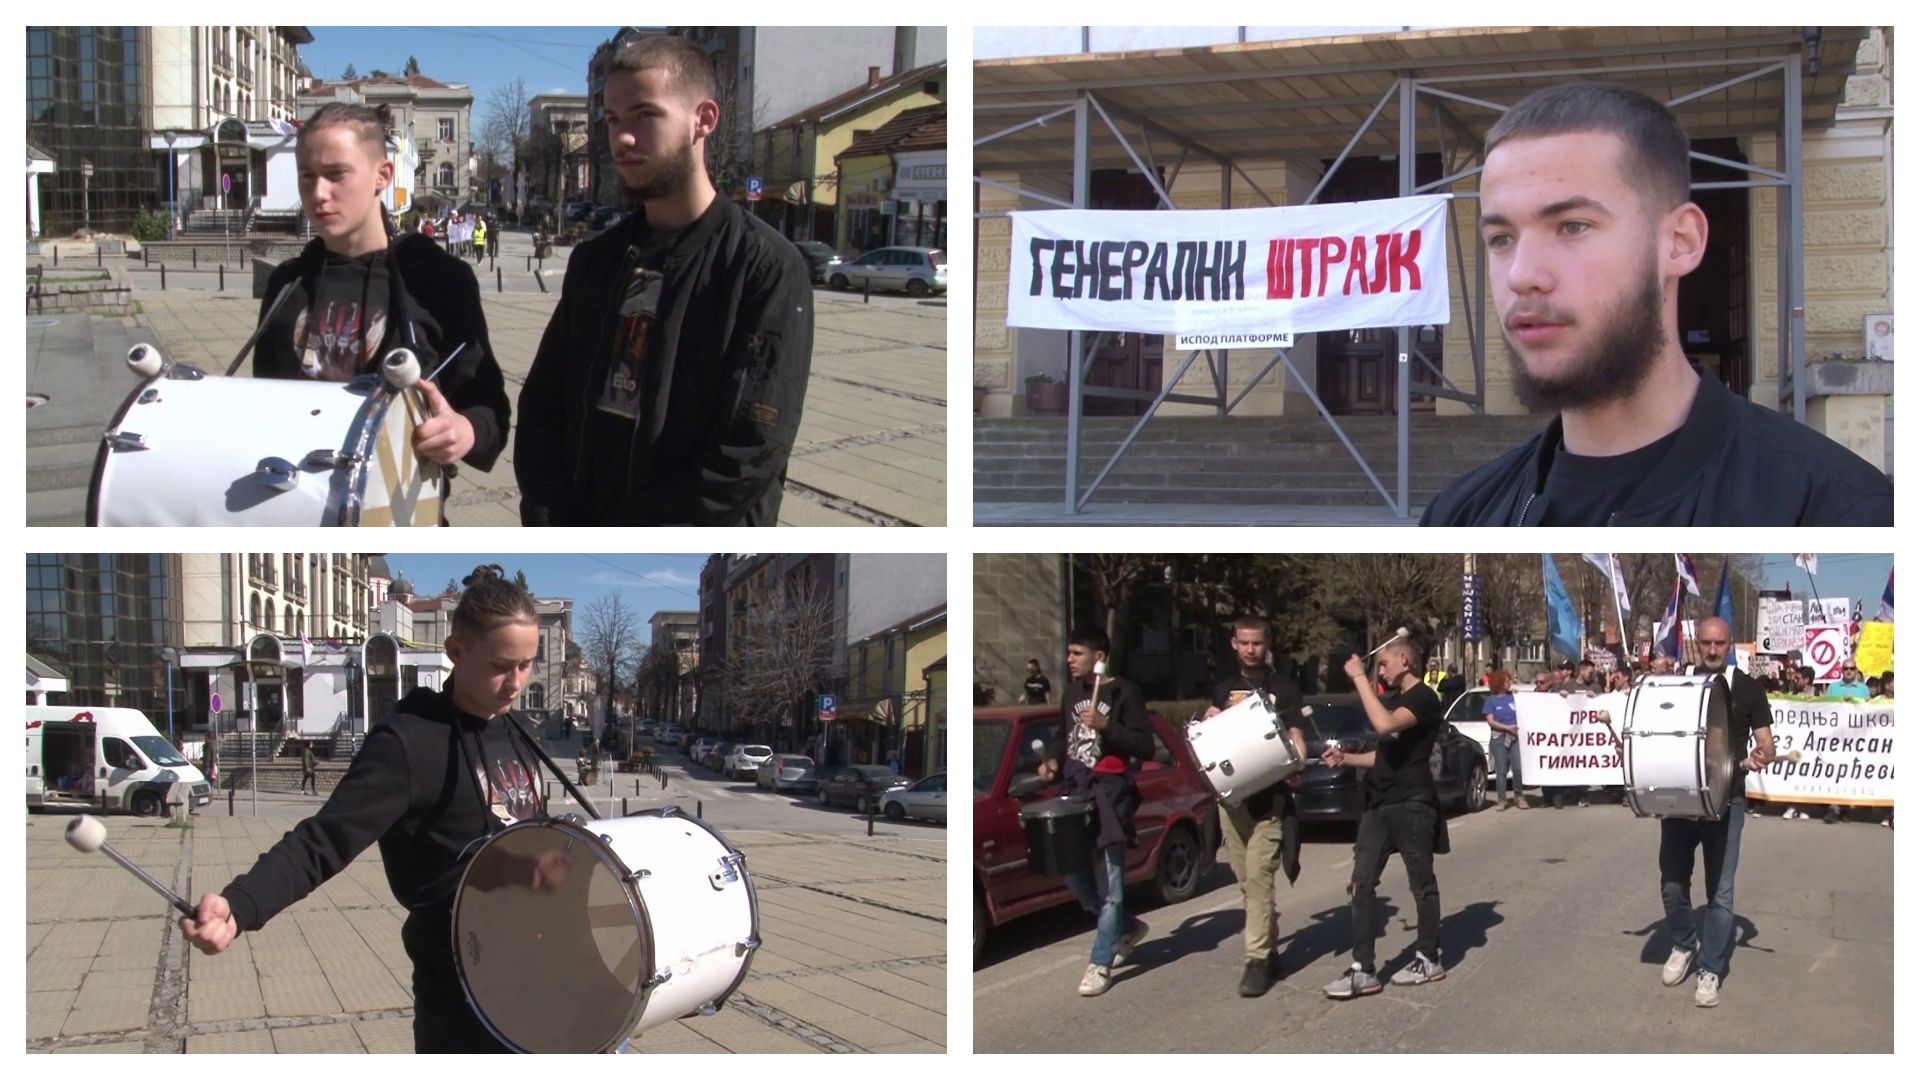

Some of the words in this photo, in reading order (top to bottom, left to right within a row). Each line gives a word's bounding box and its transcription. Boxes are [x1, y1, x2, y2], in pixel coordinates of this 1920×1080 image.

[1029, 237, 1247, 301] ГЕНЕРАЛНИ
[1266, 229, 1422, 300] ШТРАЈК
[1180, 335, 1218, 346] ИСПОД
[1220, 333, 1289, 345] ПЛАТФОРМЕ
[1569, 710, 1599, 725] ПРВ
[1774, 708, 1839, 729] редња
[1526, 731, 1618, 748] КРАГУЈЕВА
[1538, 754, 1624, 770] ГИМНАЗИ
[1758, 756, 1895, 785] арађорђев
